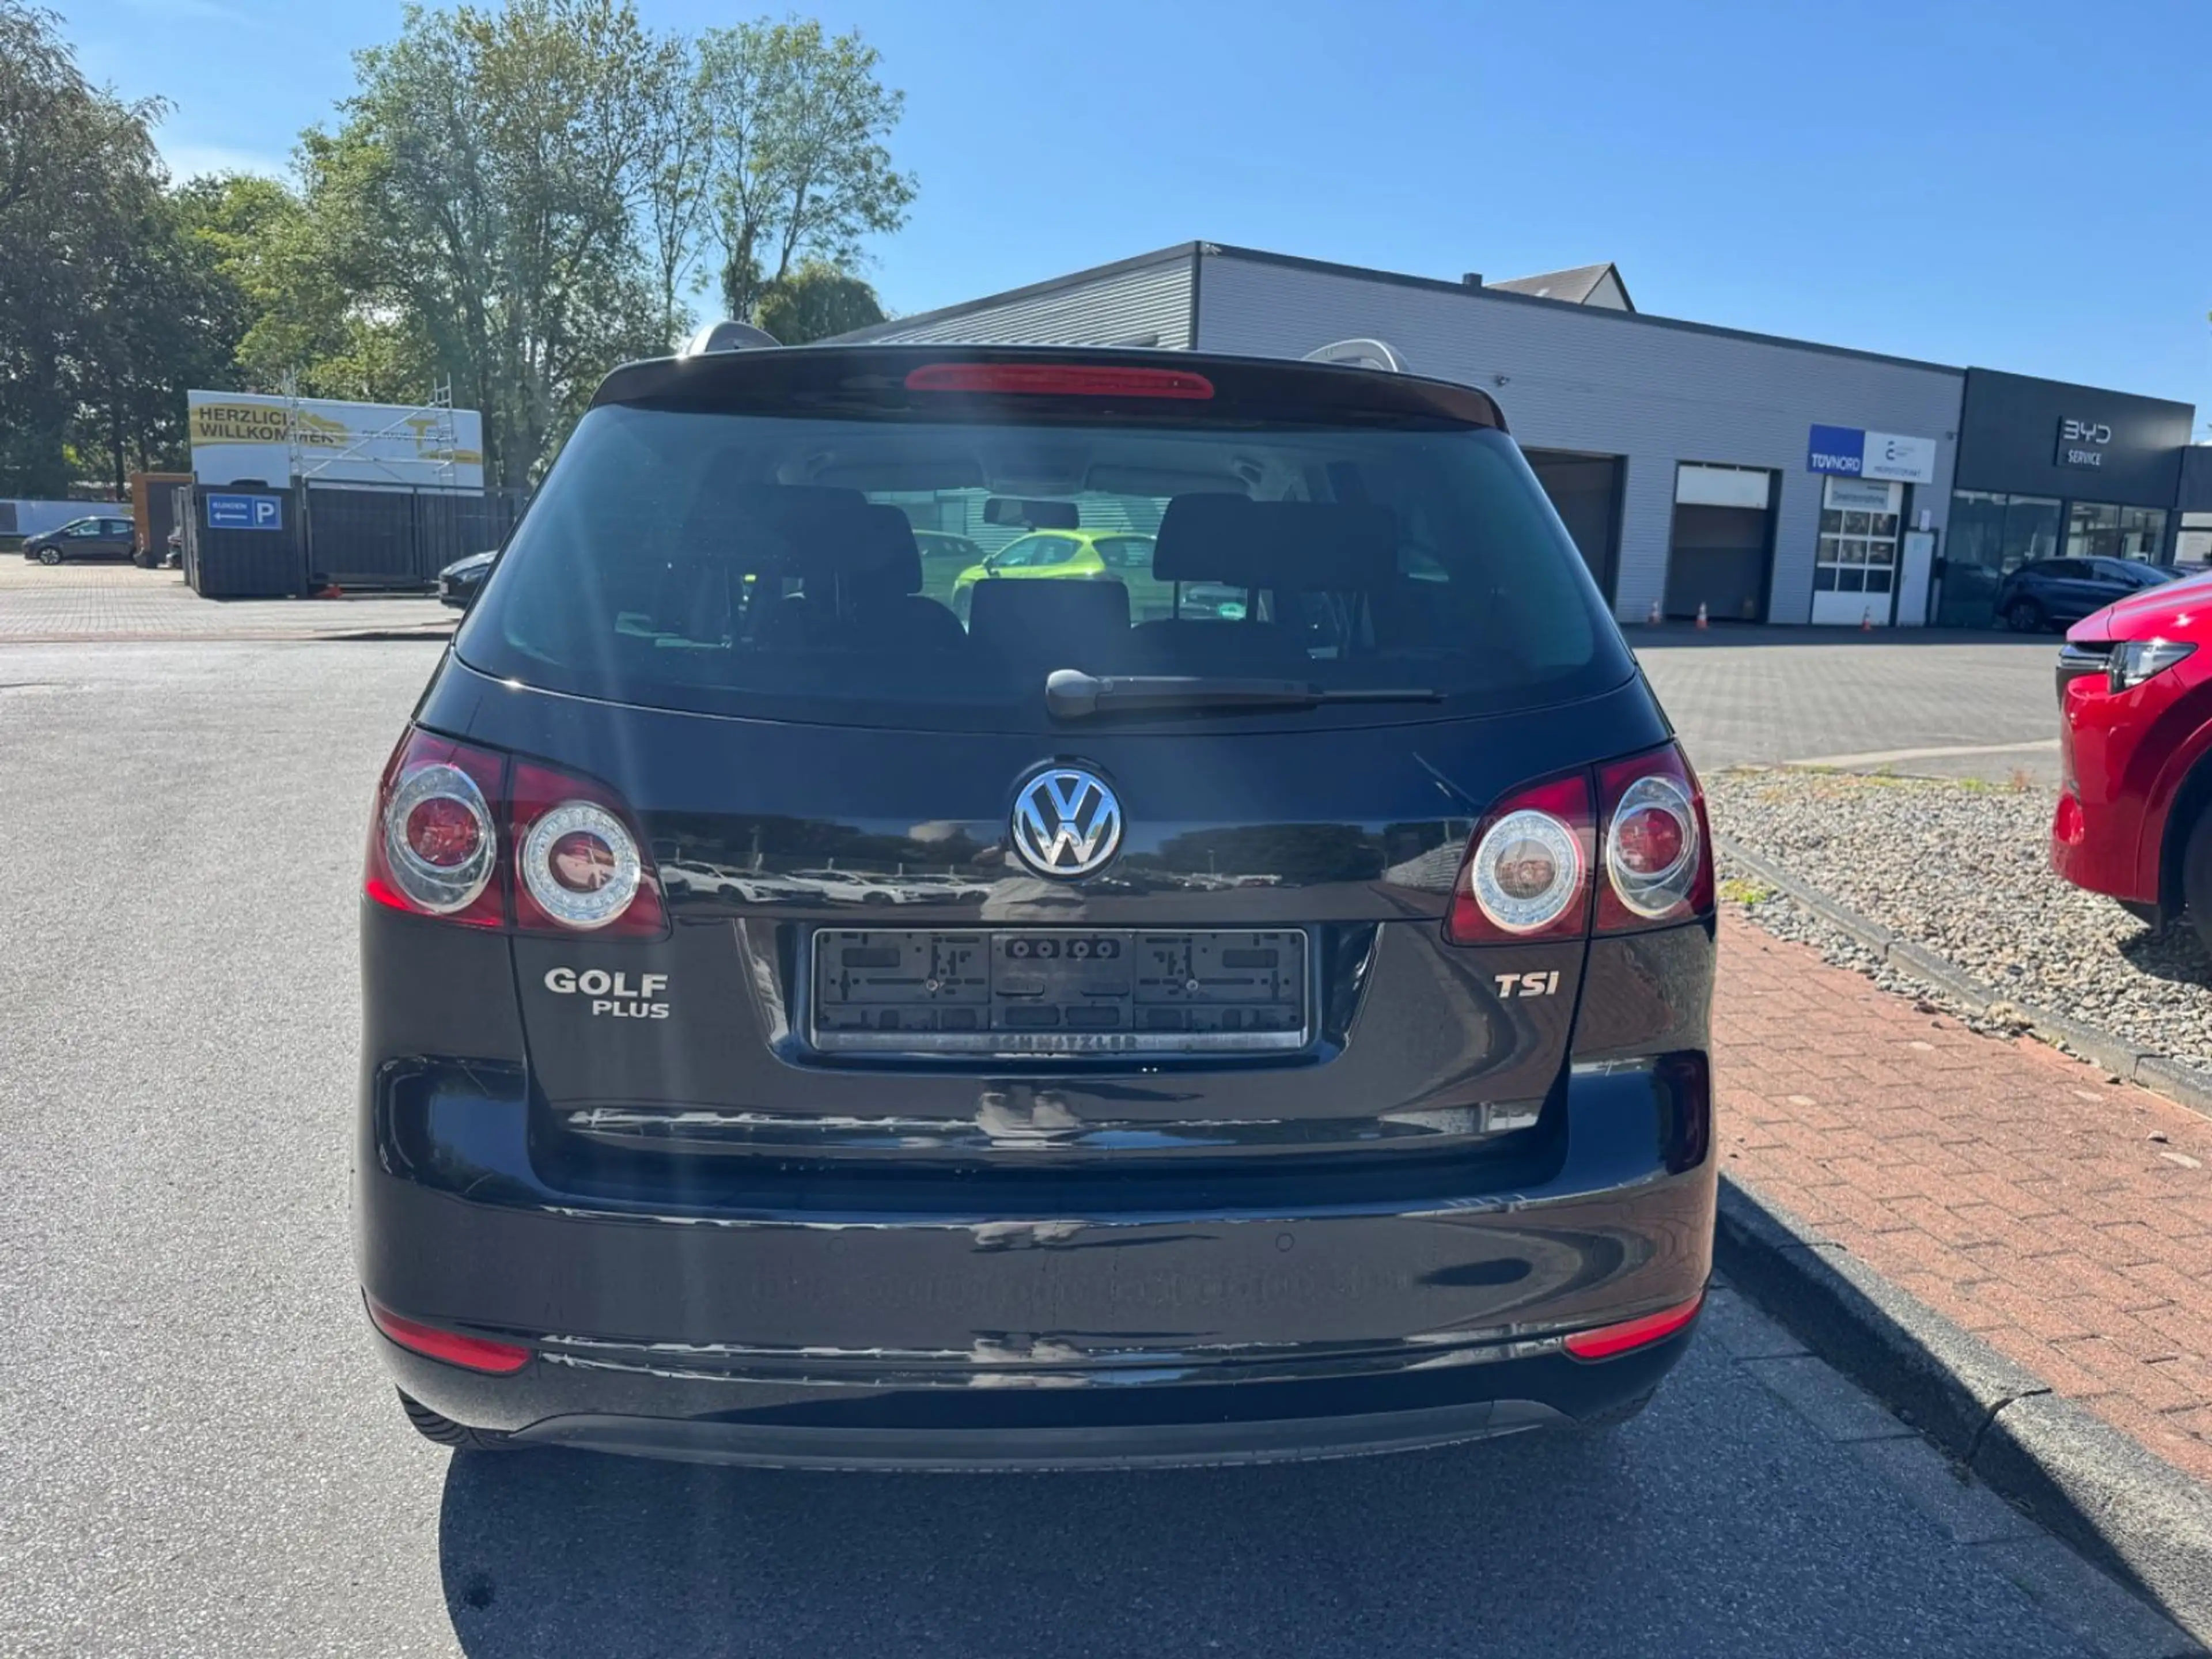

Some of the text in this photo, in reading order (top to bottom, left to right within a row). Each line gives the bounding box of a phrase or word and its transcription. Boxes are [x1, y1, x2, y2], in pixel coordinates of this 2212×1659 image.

[2068, 449, 2102, 466] SERVICE
[544, 967, 668, 998] GOLF
[1494, 970, 1559, 998] TSI
[592, 999, 669, 1018] PLUS
